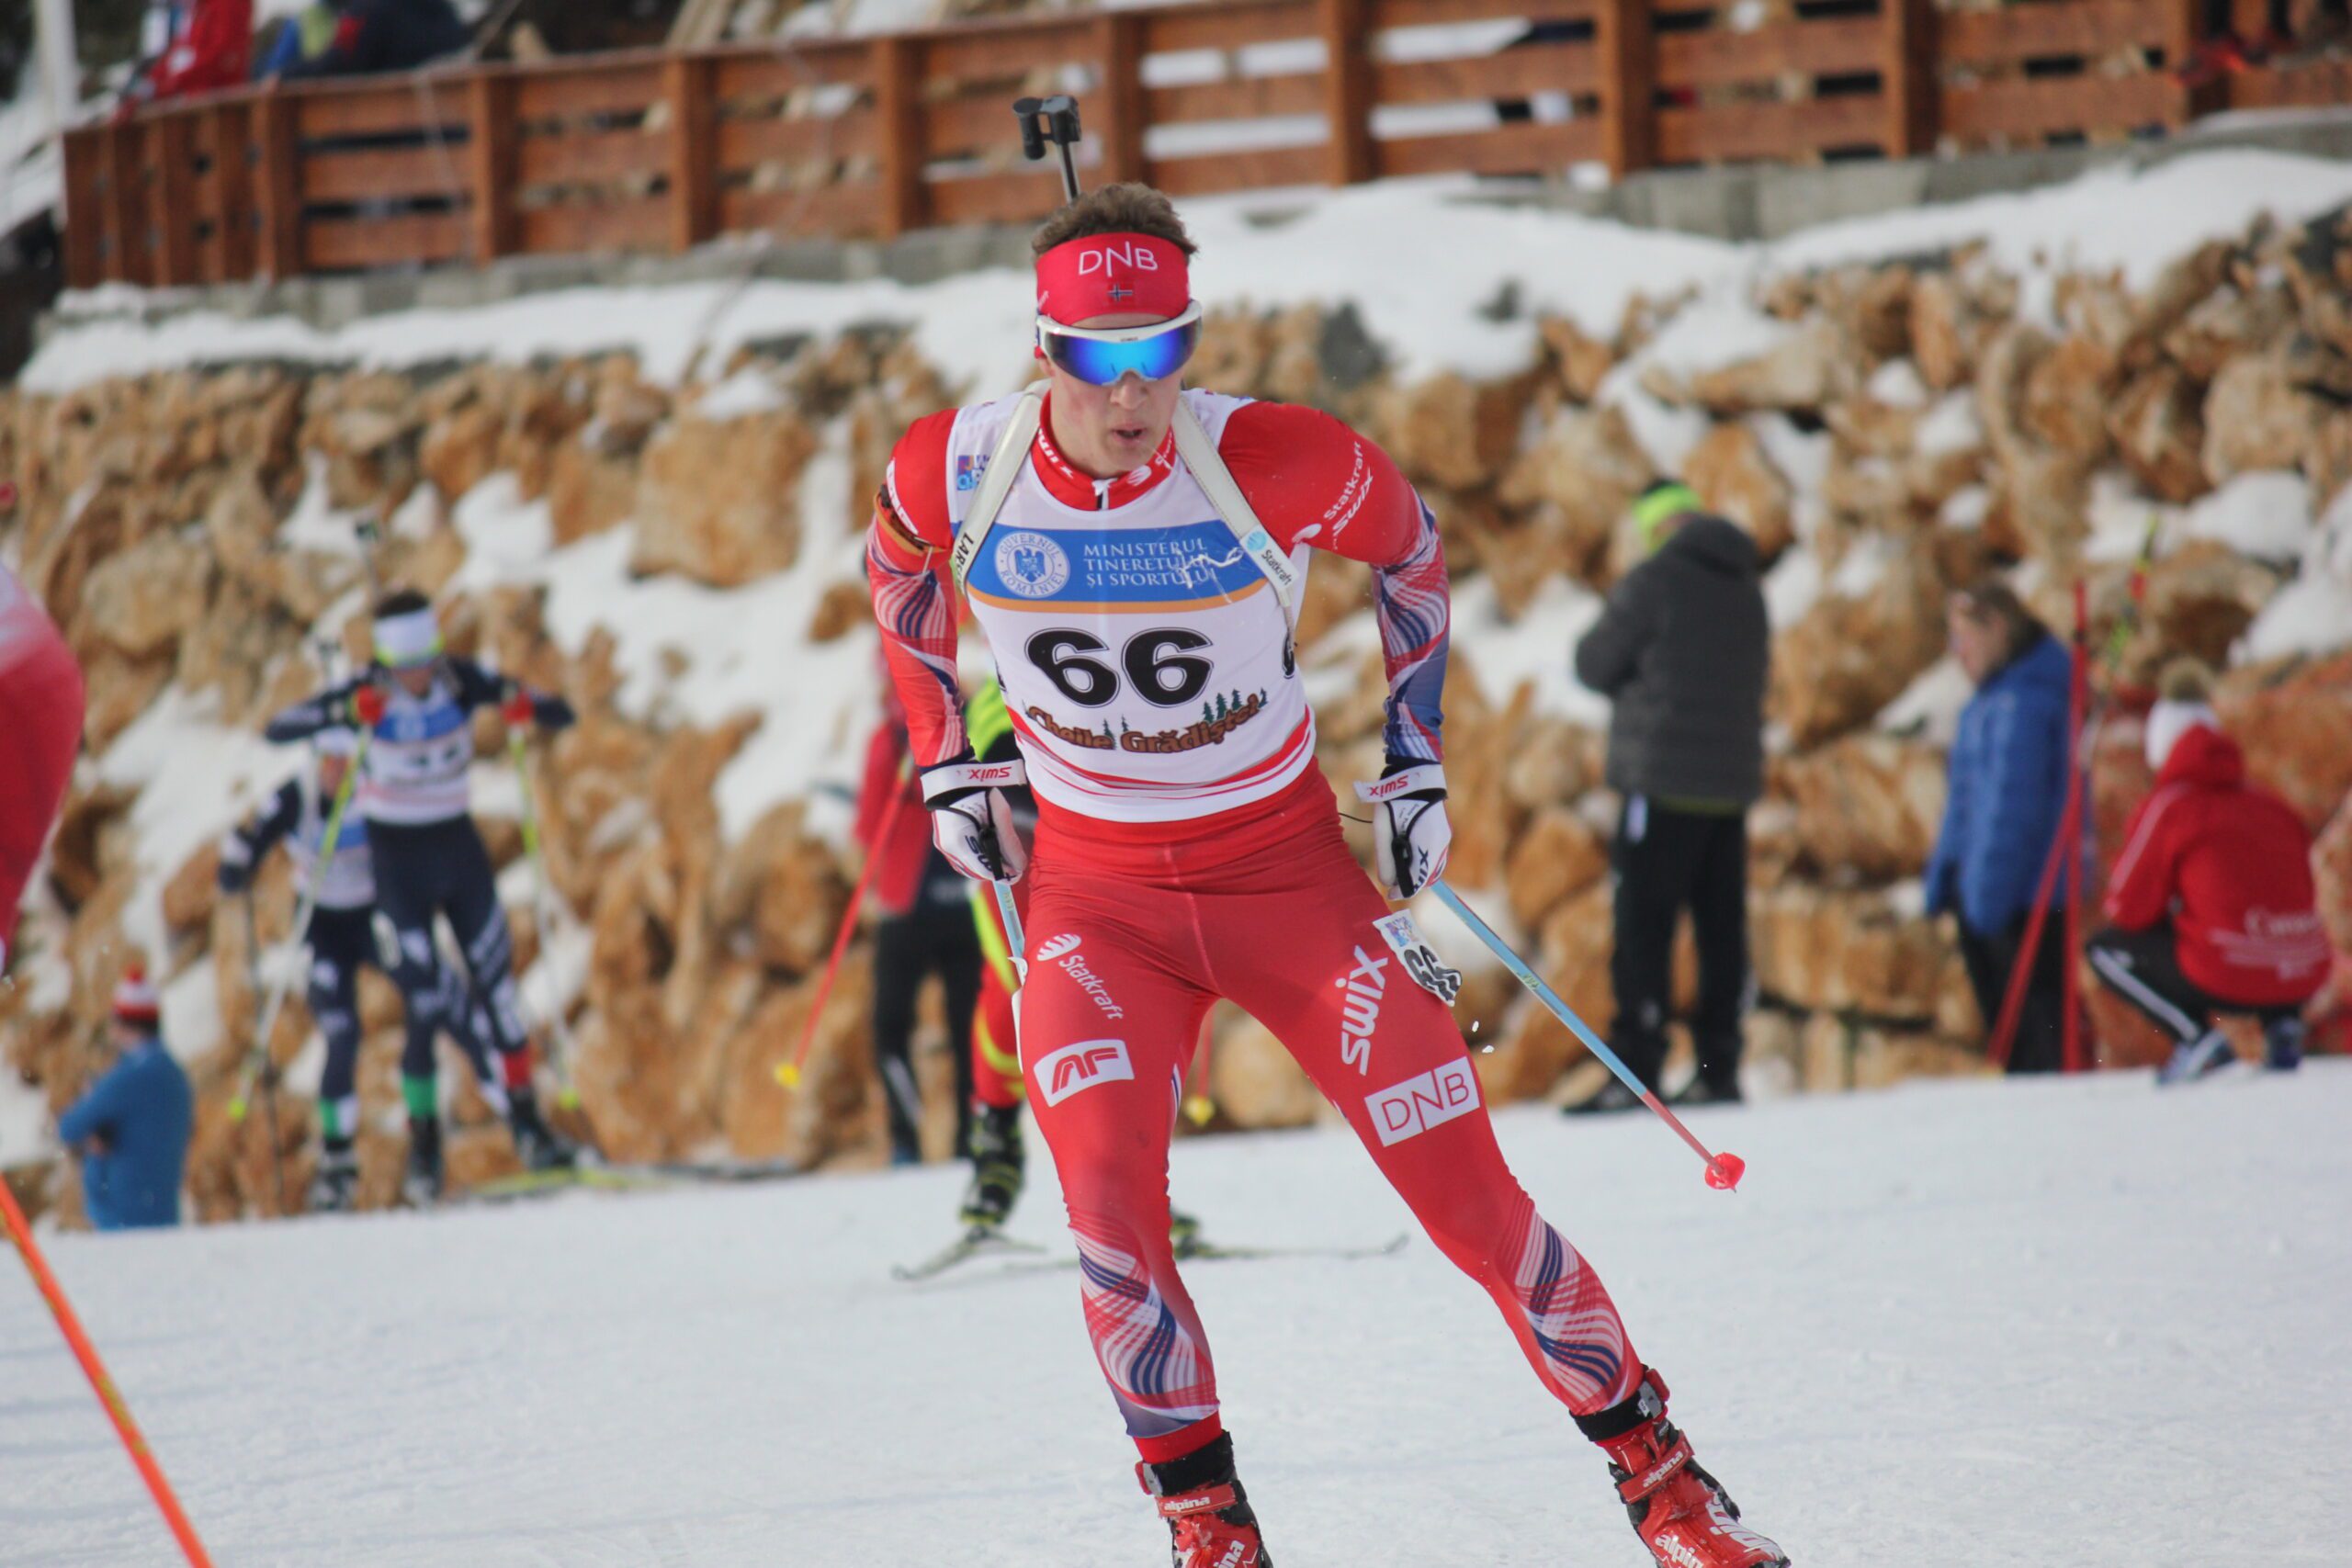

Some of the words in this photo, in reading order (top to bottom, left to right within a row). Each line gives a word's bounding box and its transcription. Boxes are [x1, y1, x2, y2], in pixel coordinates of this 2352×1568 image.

[1079, 241, 1159, 277] DNB
[1000, 534, 1060, 558] GUVERNUL
[1083, 537, 1208, 558] MINISTERUL
[1000, 569, 1065, 595] ROMÂNIEI
[1261, 549, 1292, 586] Statkraft
[1024, 626, 1216, 709] 66
[1028, 705, 1115, 750] Cheile
[1058, 954, 1125, 1020] Statkraft
[1381, 1070, 1470, 1133] DNB
[1643, 1450, 1684, 1488] alpina
[1164, 1496, 1211, 1512] alpina
[1655, 1534, 1705, 1568] alpin
